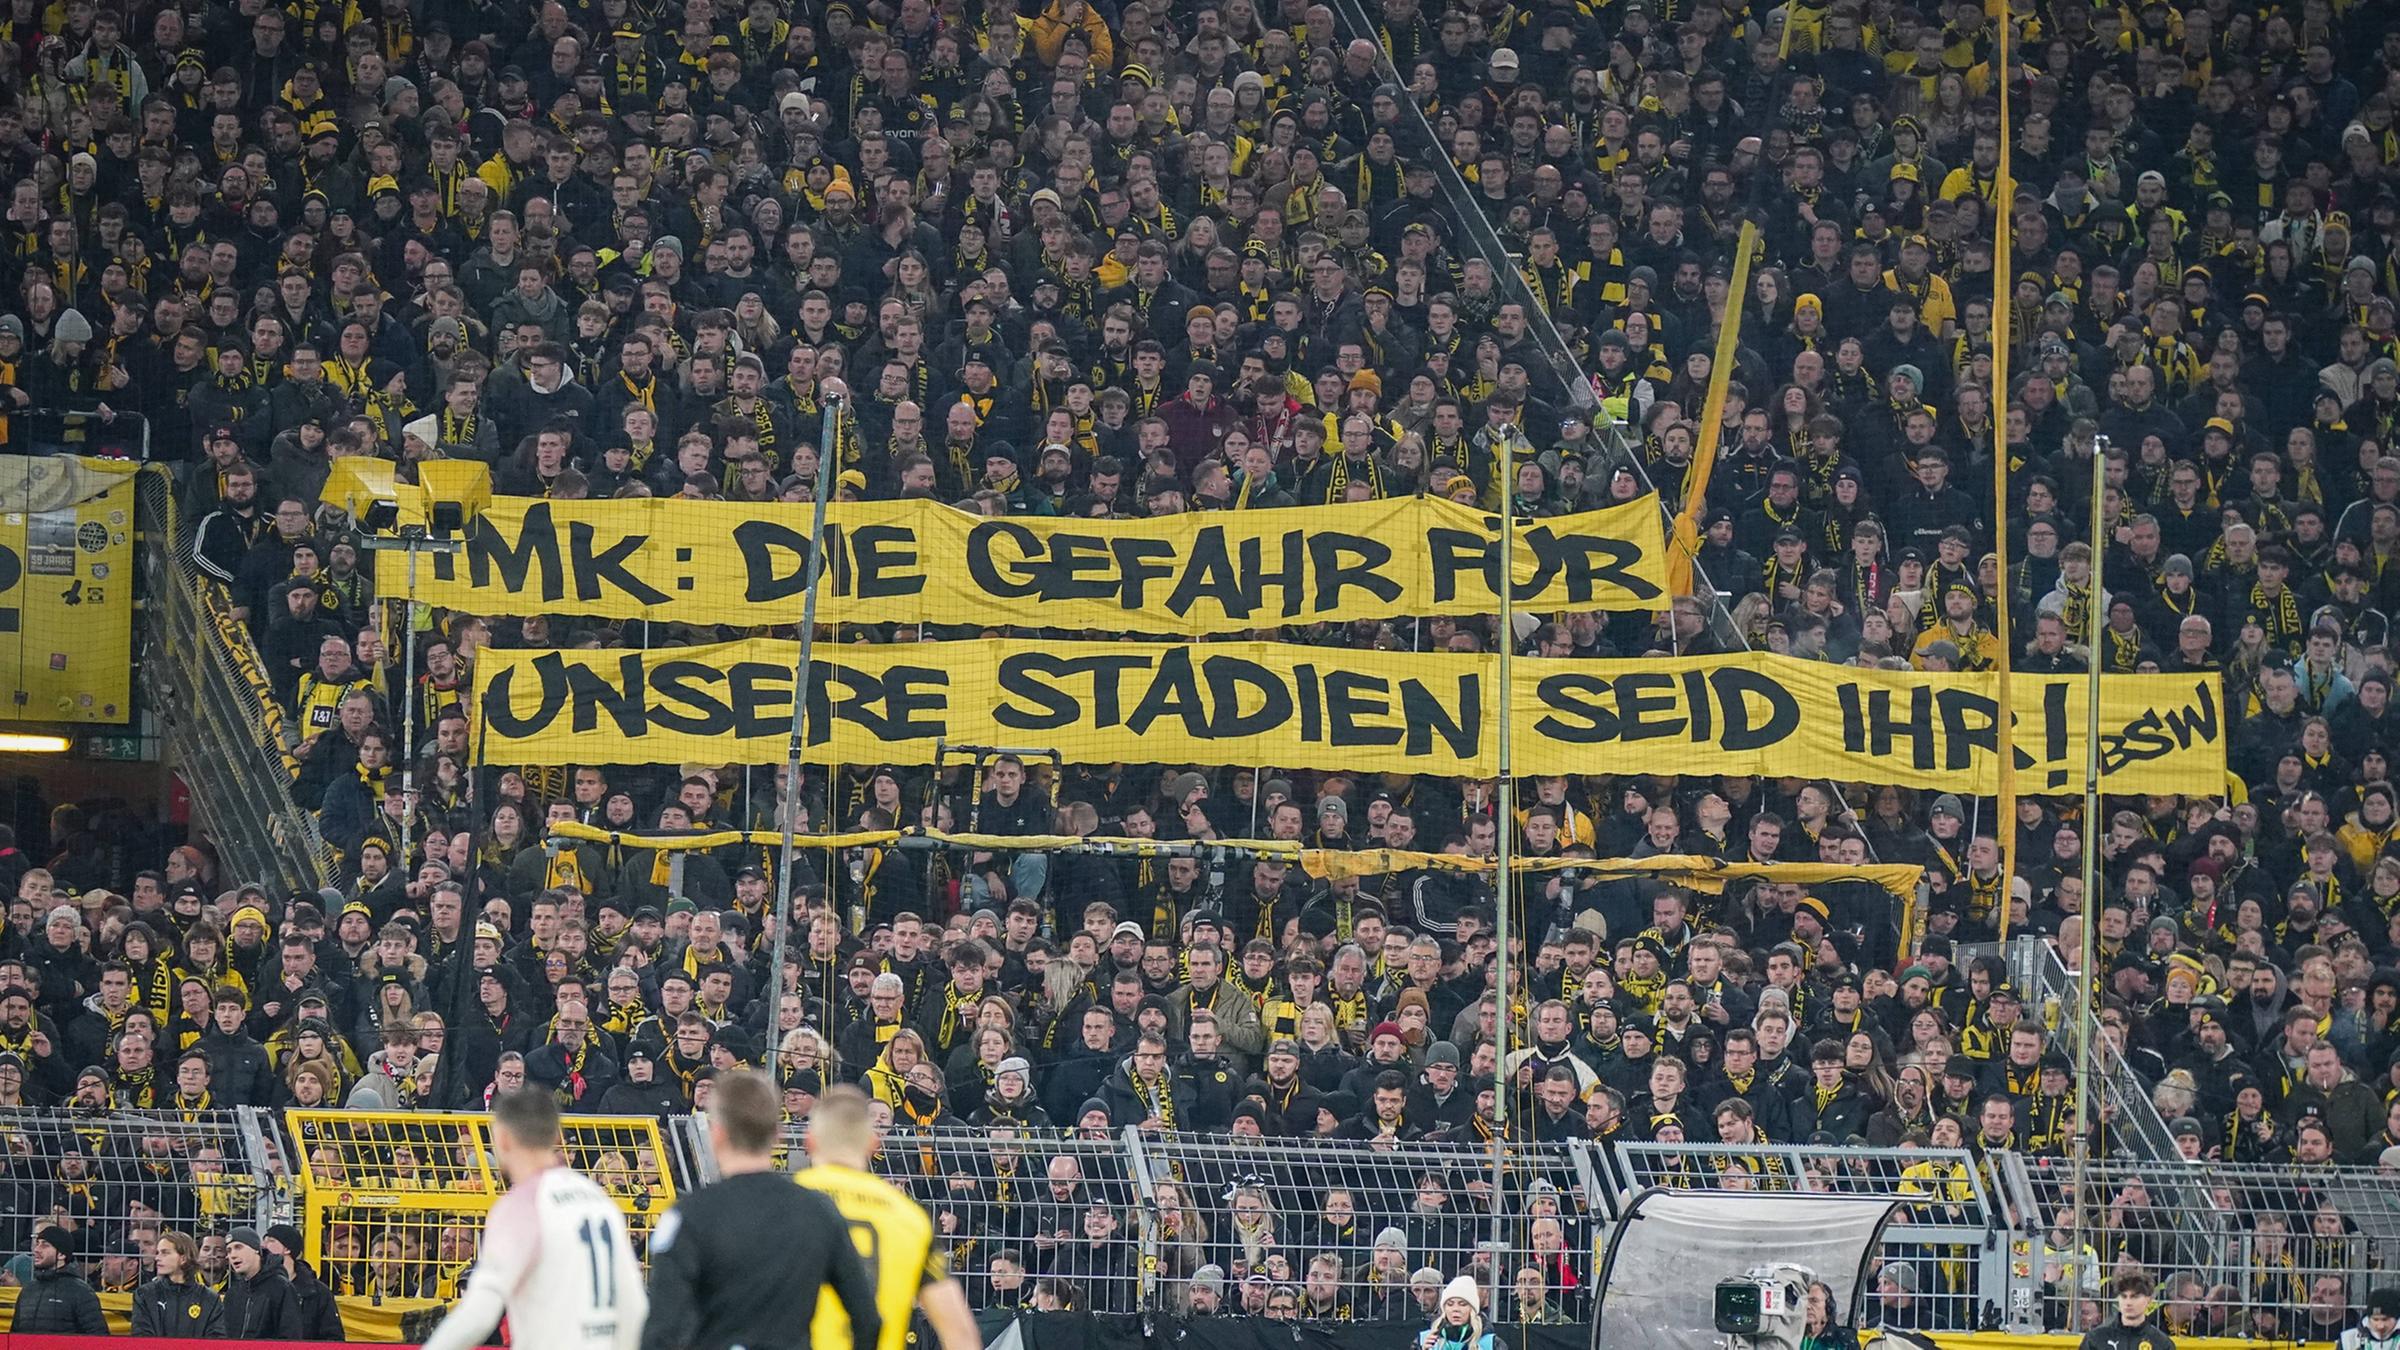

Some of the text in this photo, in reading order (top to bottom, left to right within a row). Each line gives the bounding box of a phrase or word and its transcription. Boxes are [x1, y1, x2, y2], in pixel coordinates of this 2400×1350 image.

[733, 520, 928, 602] DIE
[967, 520, 1405, 620] GEFAHR
[1426, 517, 1664, 604] FÜR
[313, 710, 331, 723] 1&1
[484, 646, 2069, 790] UNSERE STADIEN SEID IHR!
[2098, 680, 2217, 776] BSW
[579, 1218, 613, 1308] 11
